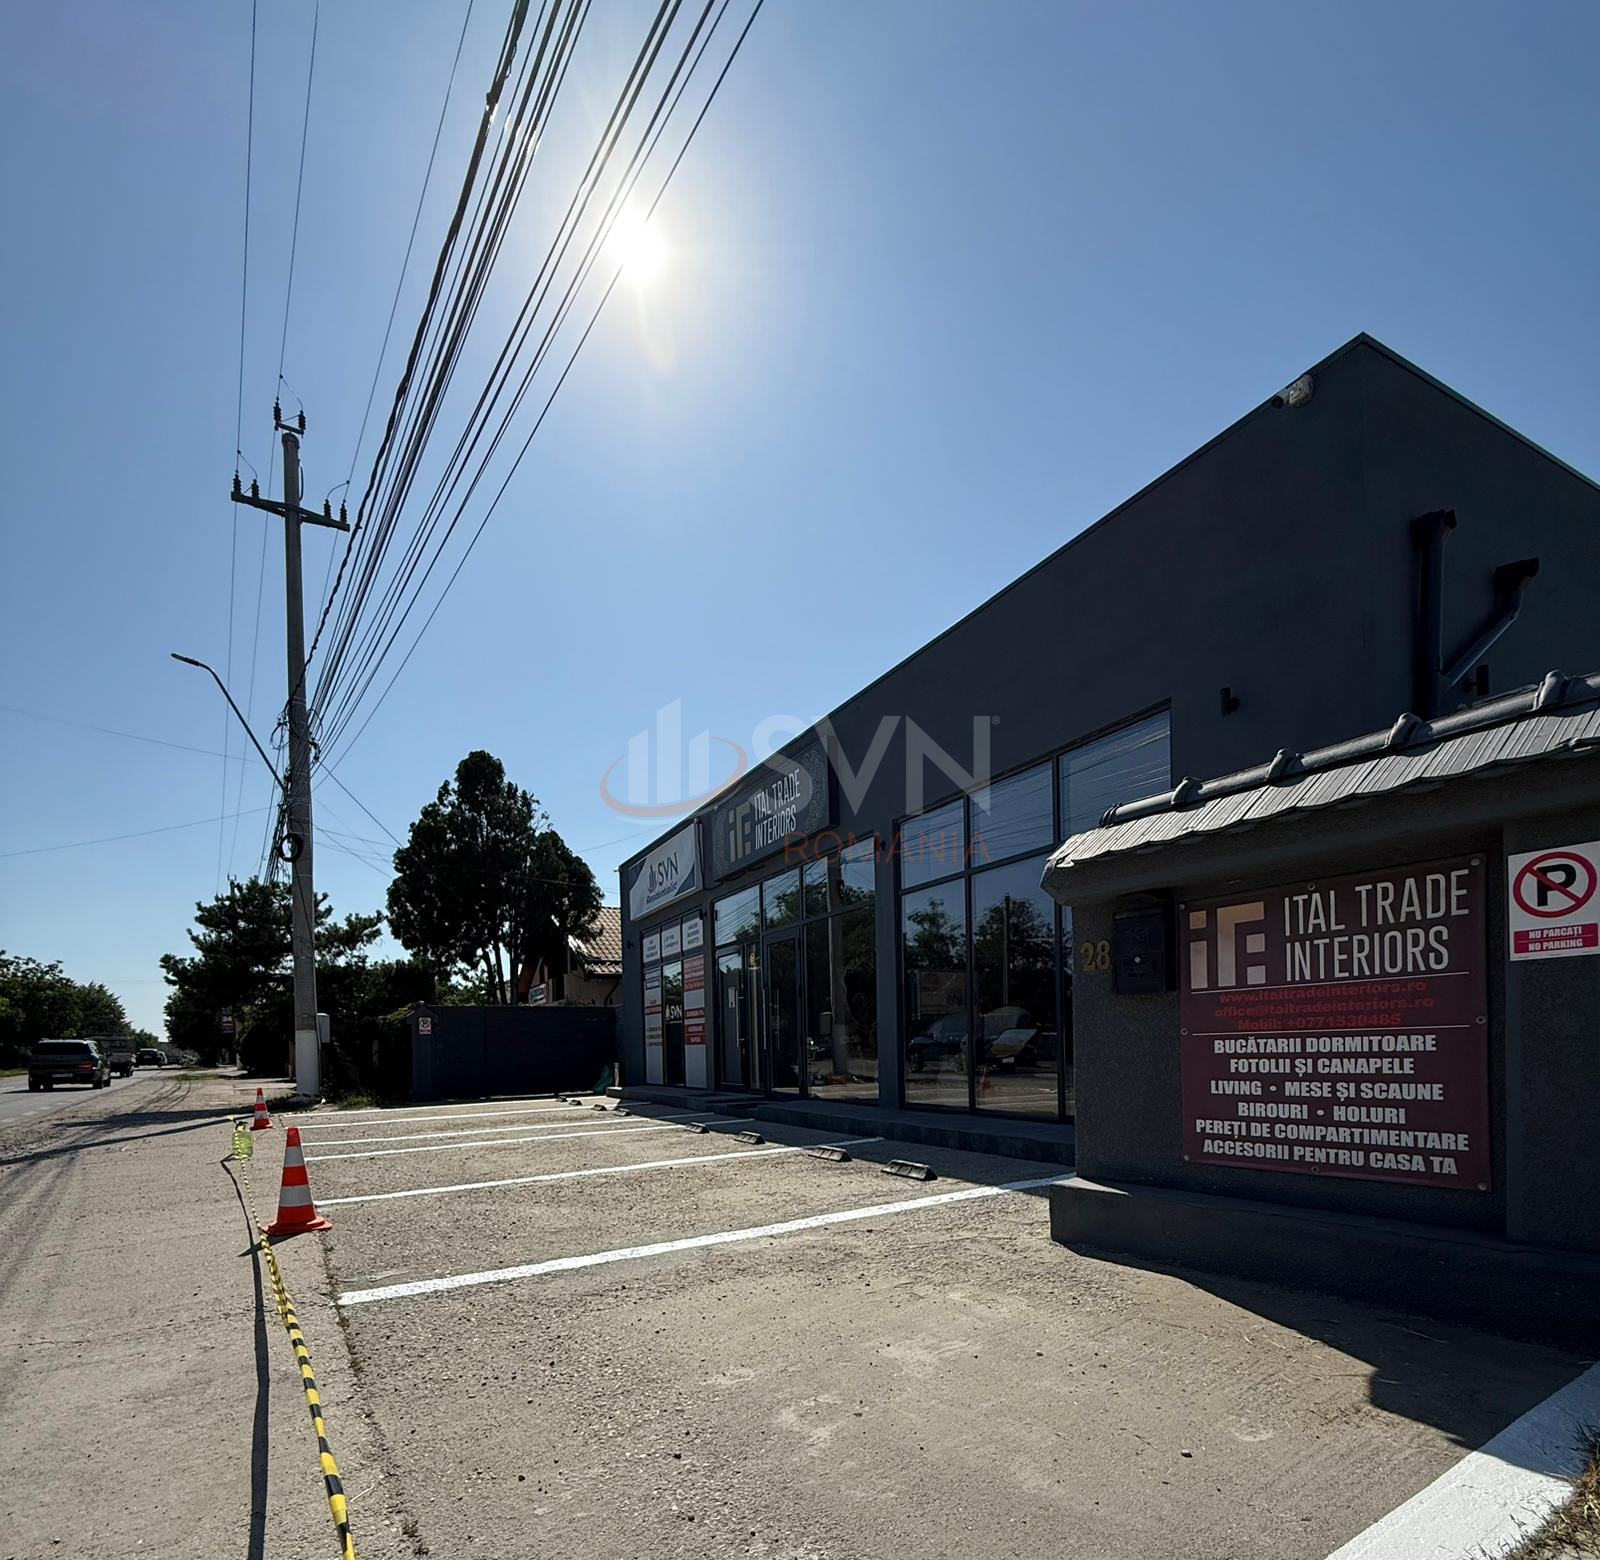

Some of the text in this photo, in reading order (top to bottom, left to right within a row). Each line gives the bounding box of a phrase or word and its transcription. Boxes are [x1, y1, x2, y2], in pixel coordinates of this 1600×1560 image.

[754, 768, 801, 821] ITAL TRADE
[755, 804, 797, 851] INTERIORS
[658, 852, 679, 887] SVN
[1284, 869, 1470, 936] ITAL TRADE
[1529, 930, 1541, 940] NU
[1529, 938, 1583, 952] NO PARKING
[1080, 939, 1111, 973] 28
[1286, 925, 1449, 981] INTERIORS
[1214, 1034, 1437, 1055] BUCĂTARII DORMITOARE
[1229, 1058, 1291, 1074] FOTOLII
[1317, 1058, 1415, 1075] CANAPELE
[1210, 1080, 1262, 1096] LIVING
[1284, 1082, 1333, 1098] MESE
[1360, 1082, 1445, 1101] SCAUNE
[1237, 1101, 1407, 1125] BIROURI HOLURI
[1250, 1121, 1271, 1138] DE
[1274, 1123, 1470, 1152] COMPARTIMENTARE
[1202, 1138, 1459, 1176] ACCESORII PENTRU CASA TA
